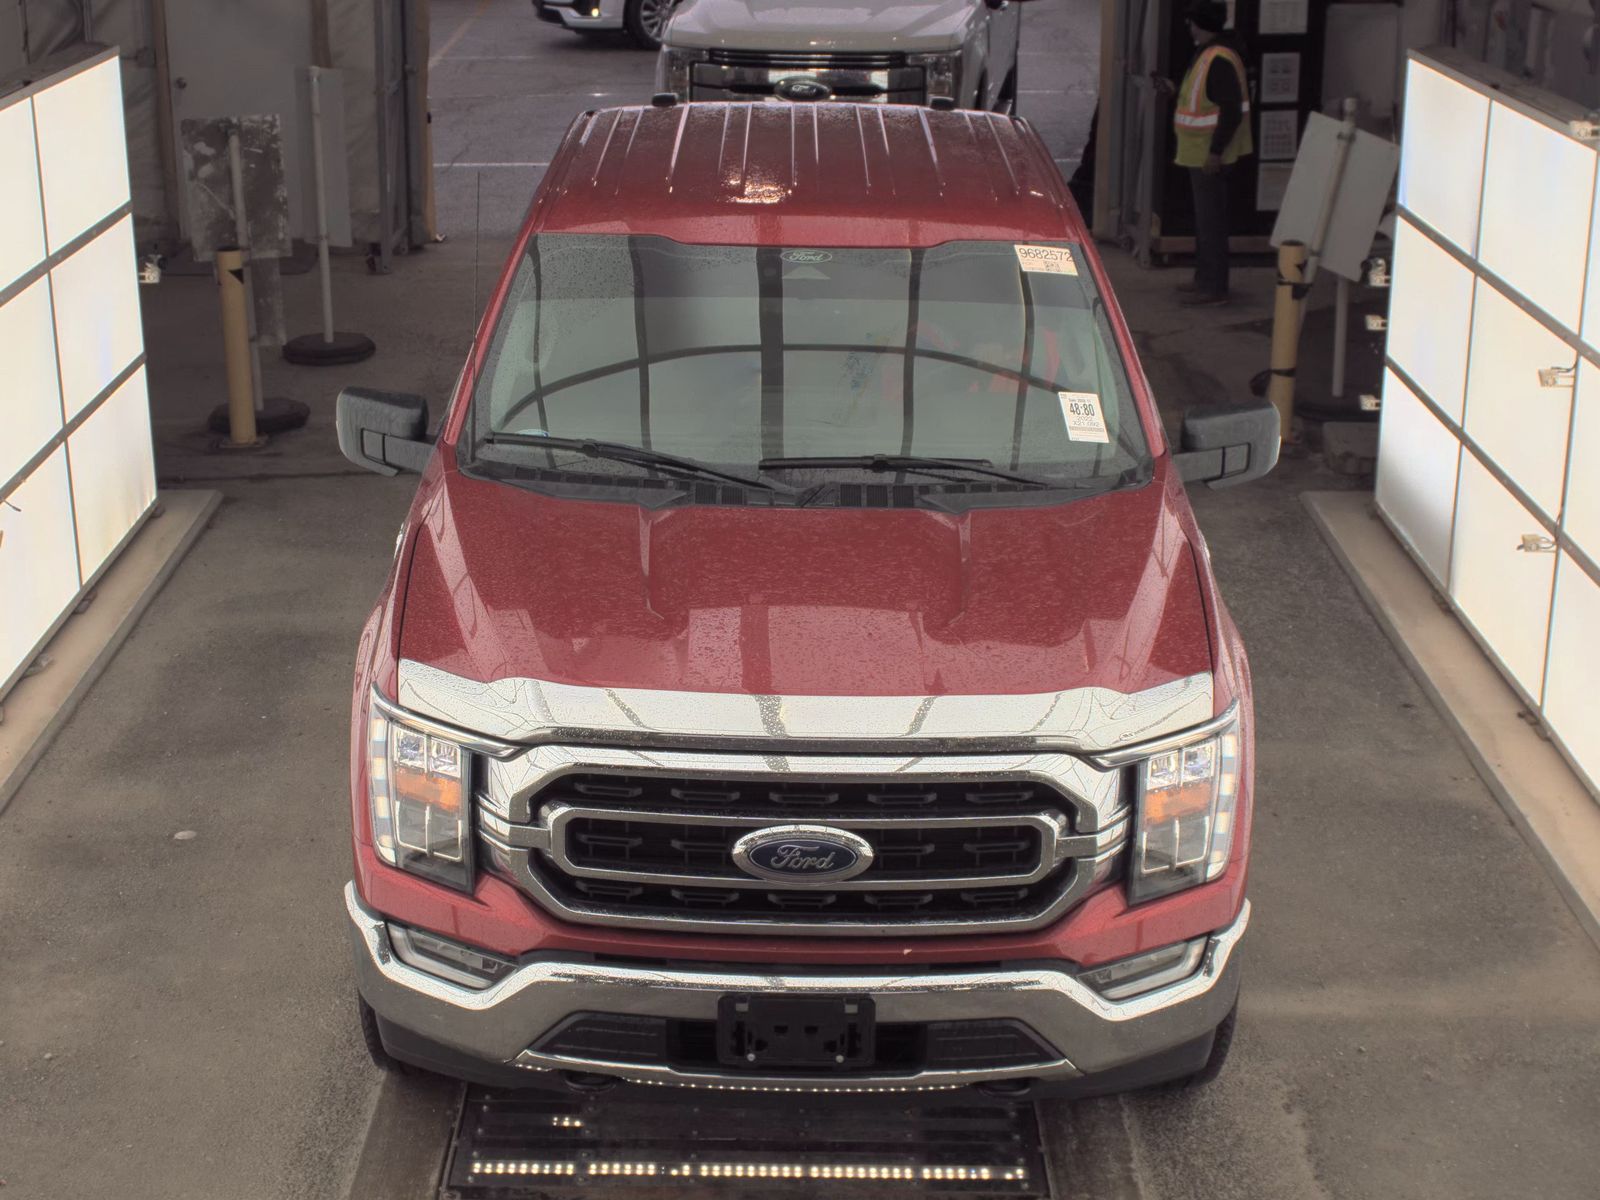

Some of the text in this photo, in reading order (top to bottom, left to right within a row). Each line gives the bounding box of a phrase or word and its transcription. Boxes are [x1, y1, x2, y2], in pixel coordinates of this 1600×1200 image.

[1019, 248, 1072, 261] 9682572
[1070, 403, 1095, 416] 48:80
[770, 844, 836, 869] Ford
